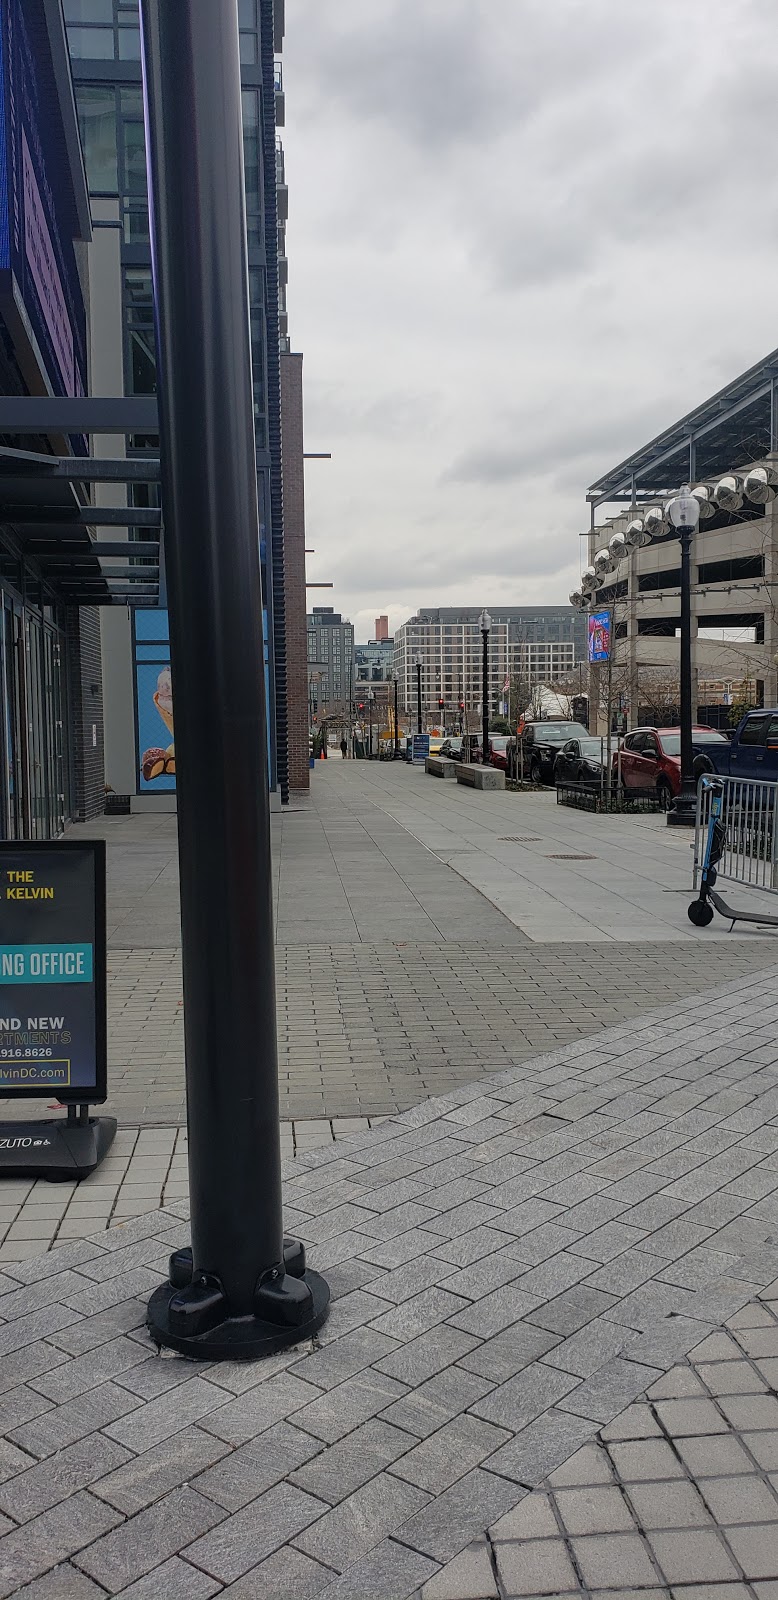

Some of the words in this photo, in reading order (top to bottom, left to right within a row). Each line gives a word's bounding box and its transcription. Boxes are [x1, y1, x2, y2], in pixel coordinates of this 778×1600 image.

[6, 870, 34, 883] THE
[6, 887, 54, 900] KELVIN
[30, 952, 85, 976] OFFICE
[27, 1016, 65, 1030] NEW
